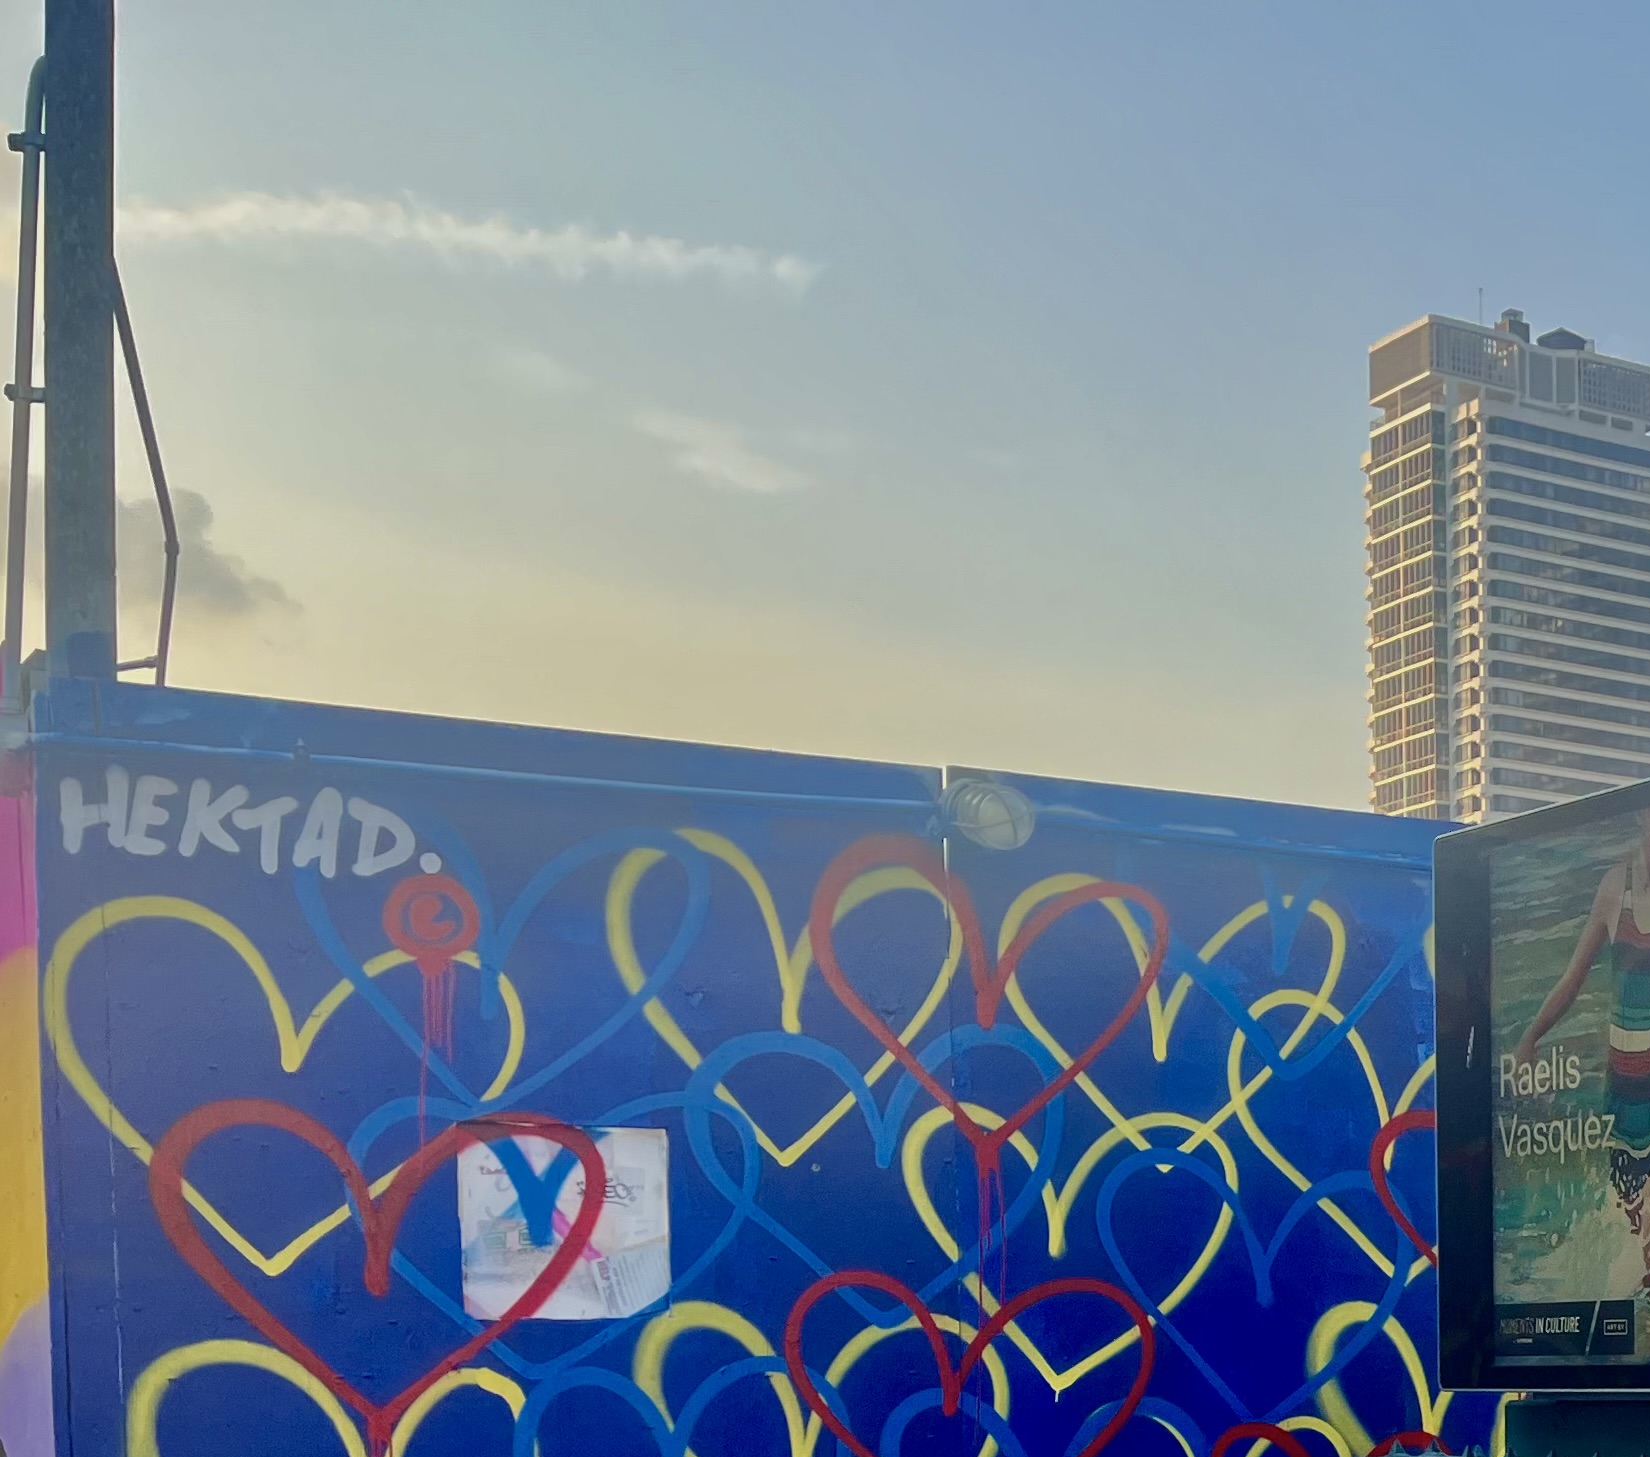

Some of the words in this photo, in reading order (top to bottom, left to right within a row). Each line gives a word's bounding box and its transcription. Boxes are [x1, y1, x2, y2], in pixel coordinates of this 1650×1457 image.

[1500, 1045, 1581, 1098] Raelis
[1499, 1114, 1616, 1165] Vasquez
[1535, 1317, 1545, 1334] IN
[1545, 1316, 1580, 1333] CULTURE
